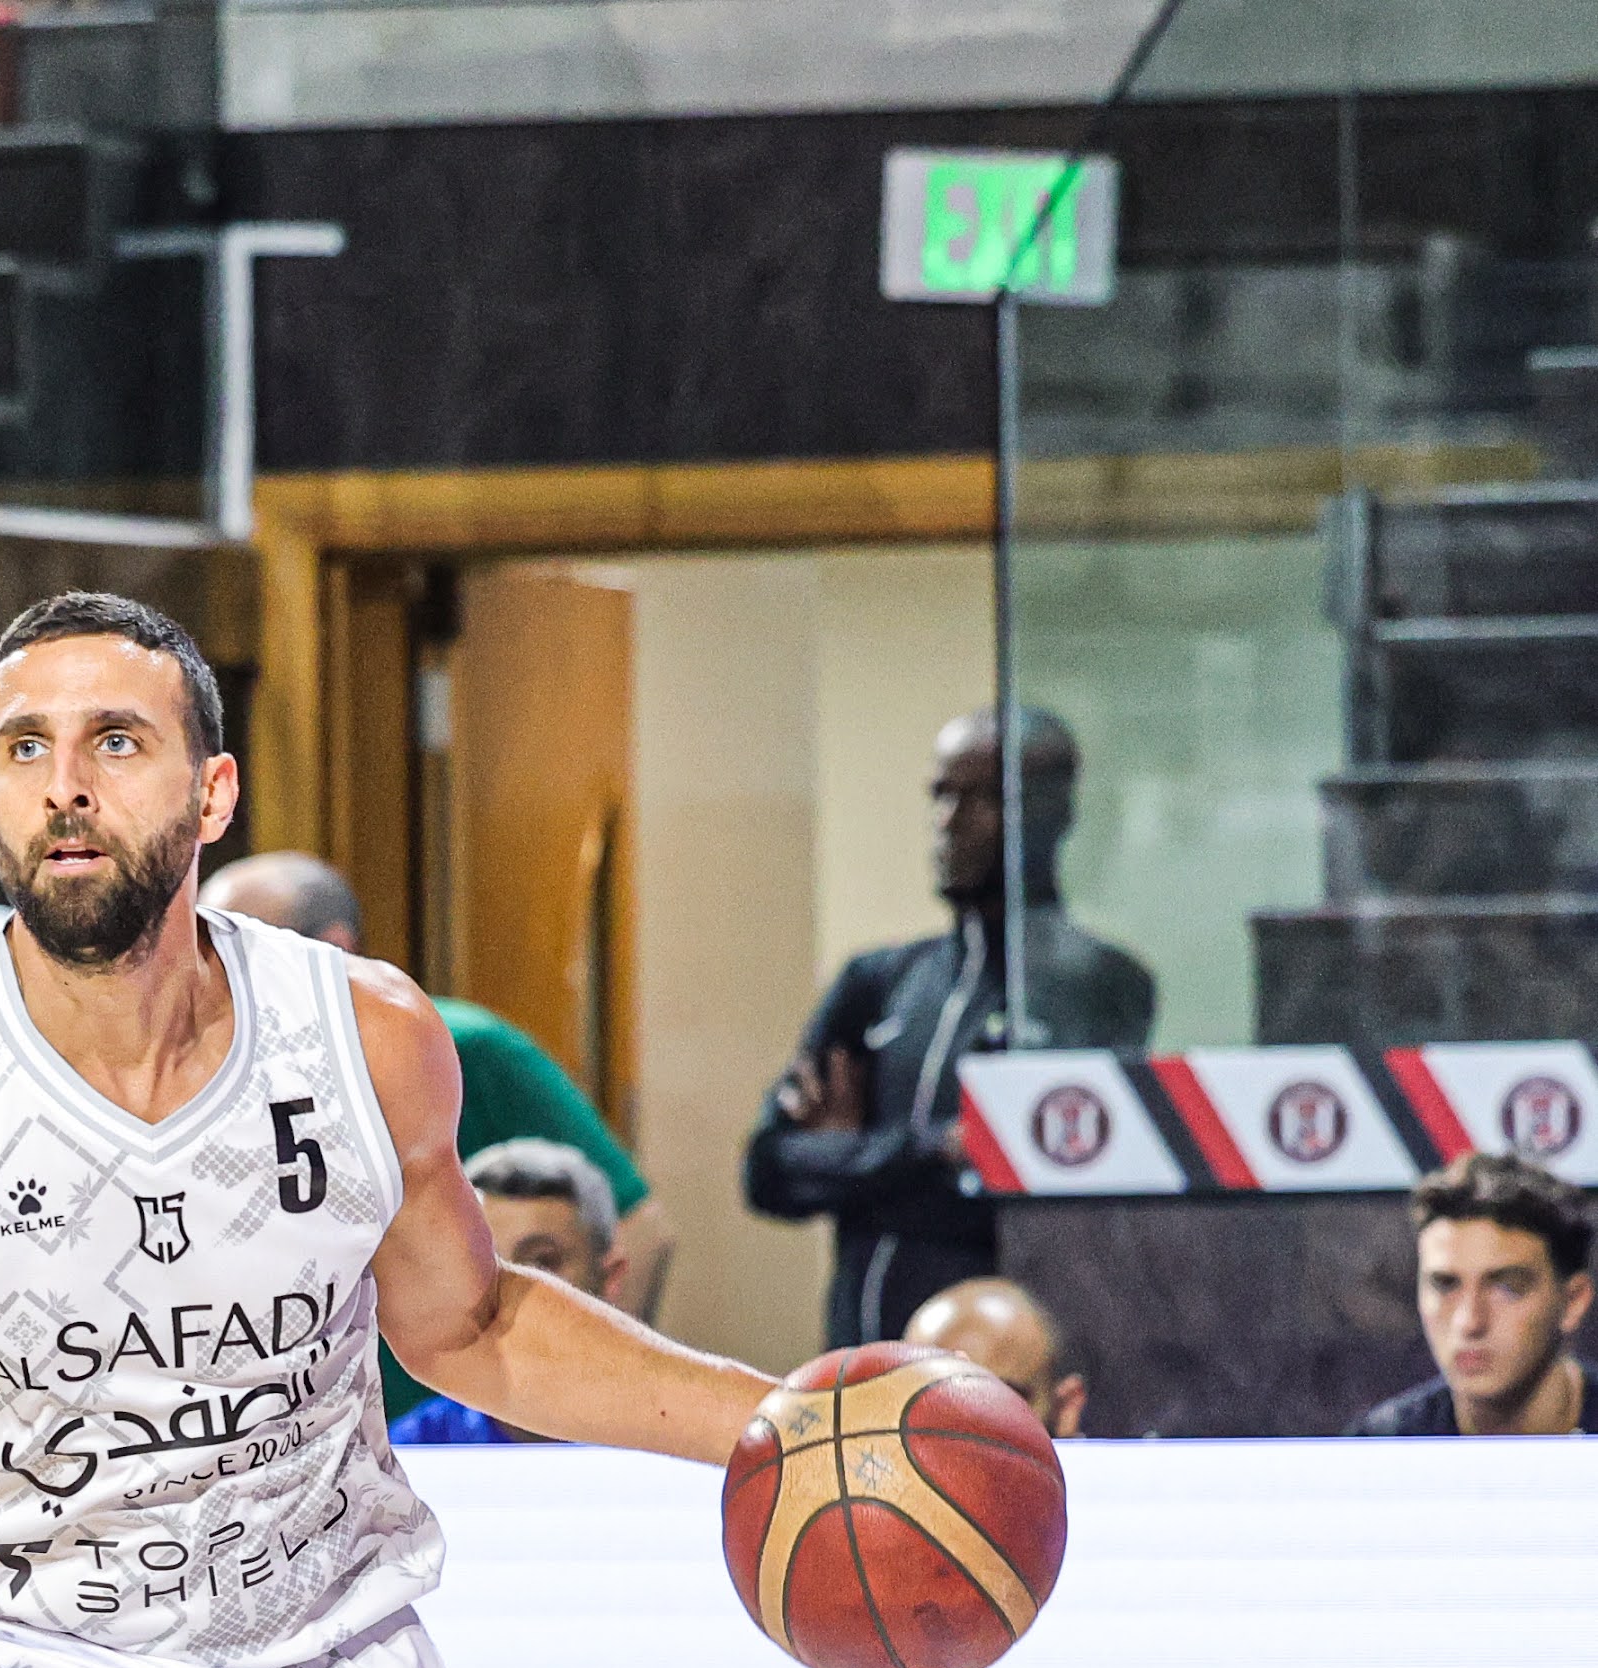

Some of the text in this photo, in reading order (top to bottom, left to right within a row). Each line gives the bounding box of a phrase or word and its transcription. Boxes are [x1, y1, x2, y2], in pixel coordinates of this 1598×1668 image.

[268, 1096, 328, 1214] 5
[0, 1215, 66, 1237] KELME
[56, 1282, 335, 1383] SAFADI
[74, 1521, 245, 1571] TOP
